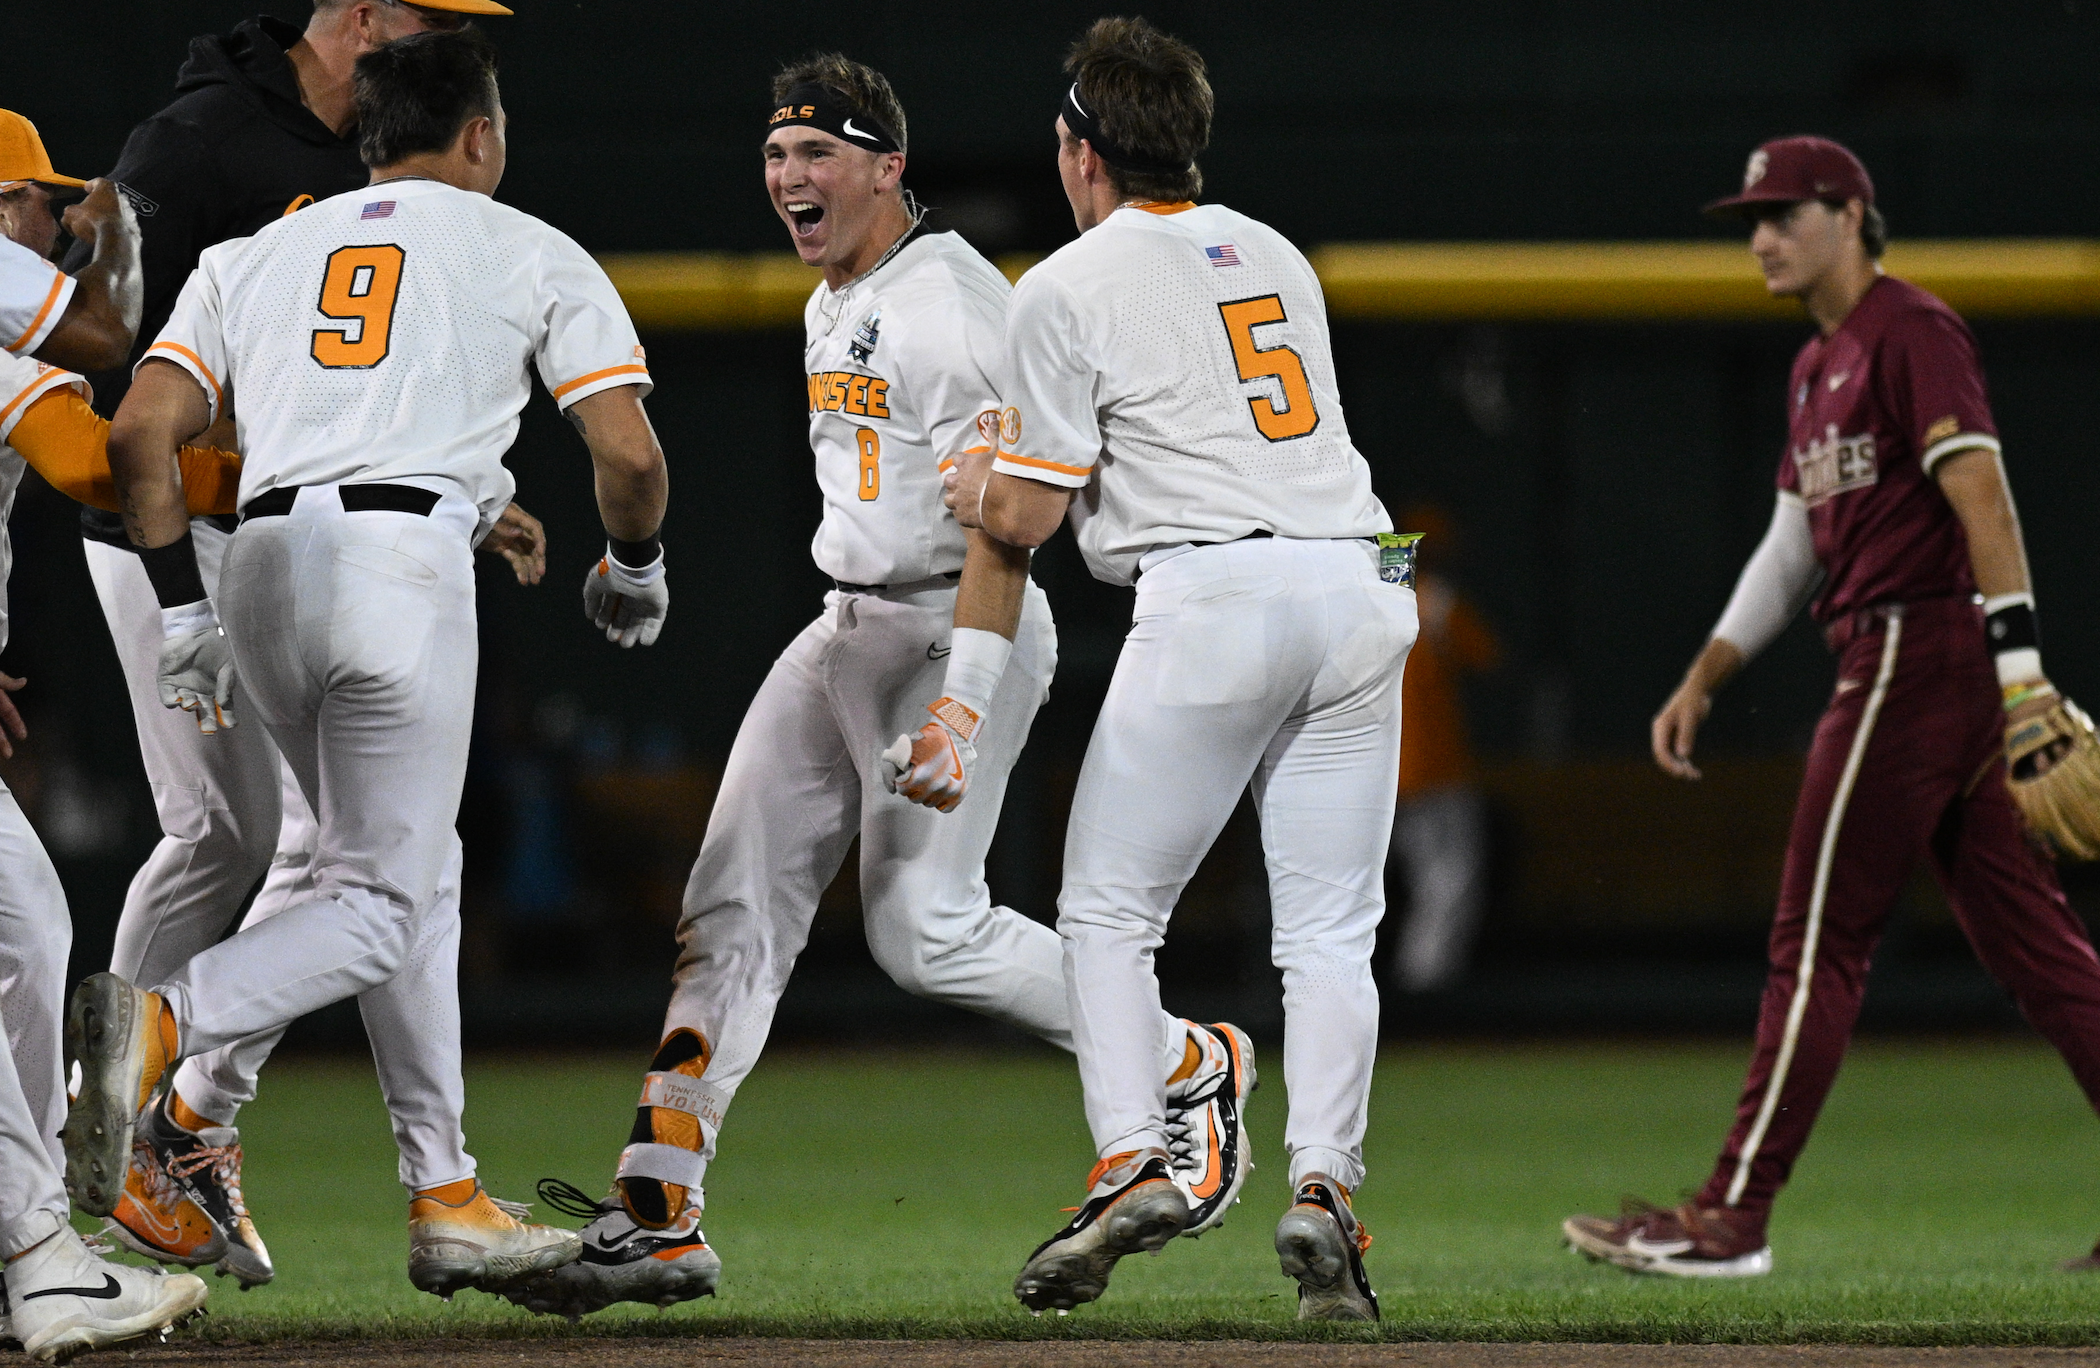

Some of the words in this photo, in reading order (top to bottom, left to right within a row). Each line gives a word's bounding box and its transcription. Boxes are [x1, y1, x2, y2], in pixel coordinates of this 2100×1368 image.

[310, 243, 406, 369] 9
[1217, 293, 1320, 443] 5
[856, 428, 880, 501] 8
[663, 1093, 724, 1126] VOLUN
[667, 1083, 716, 1106] TENNESSEE
